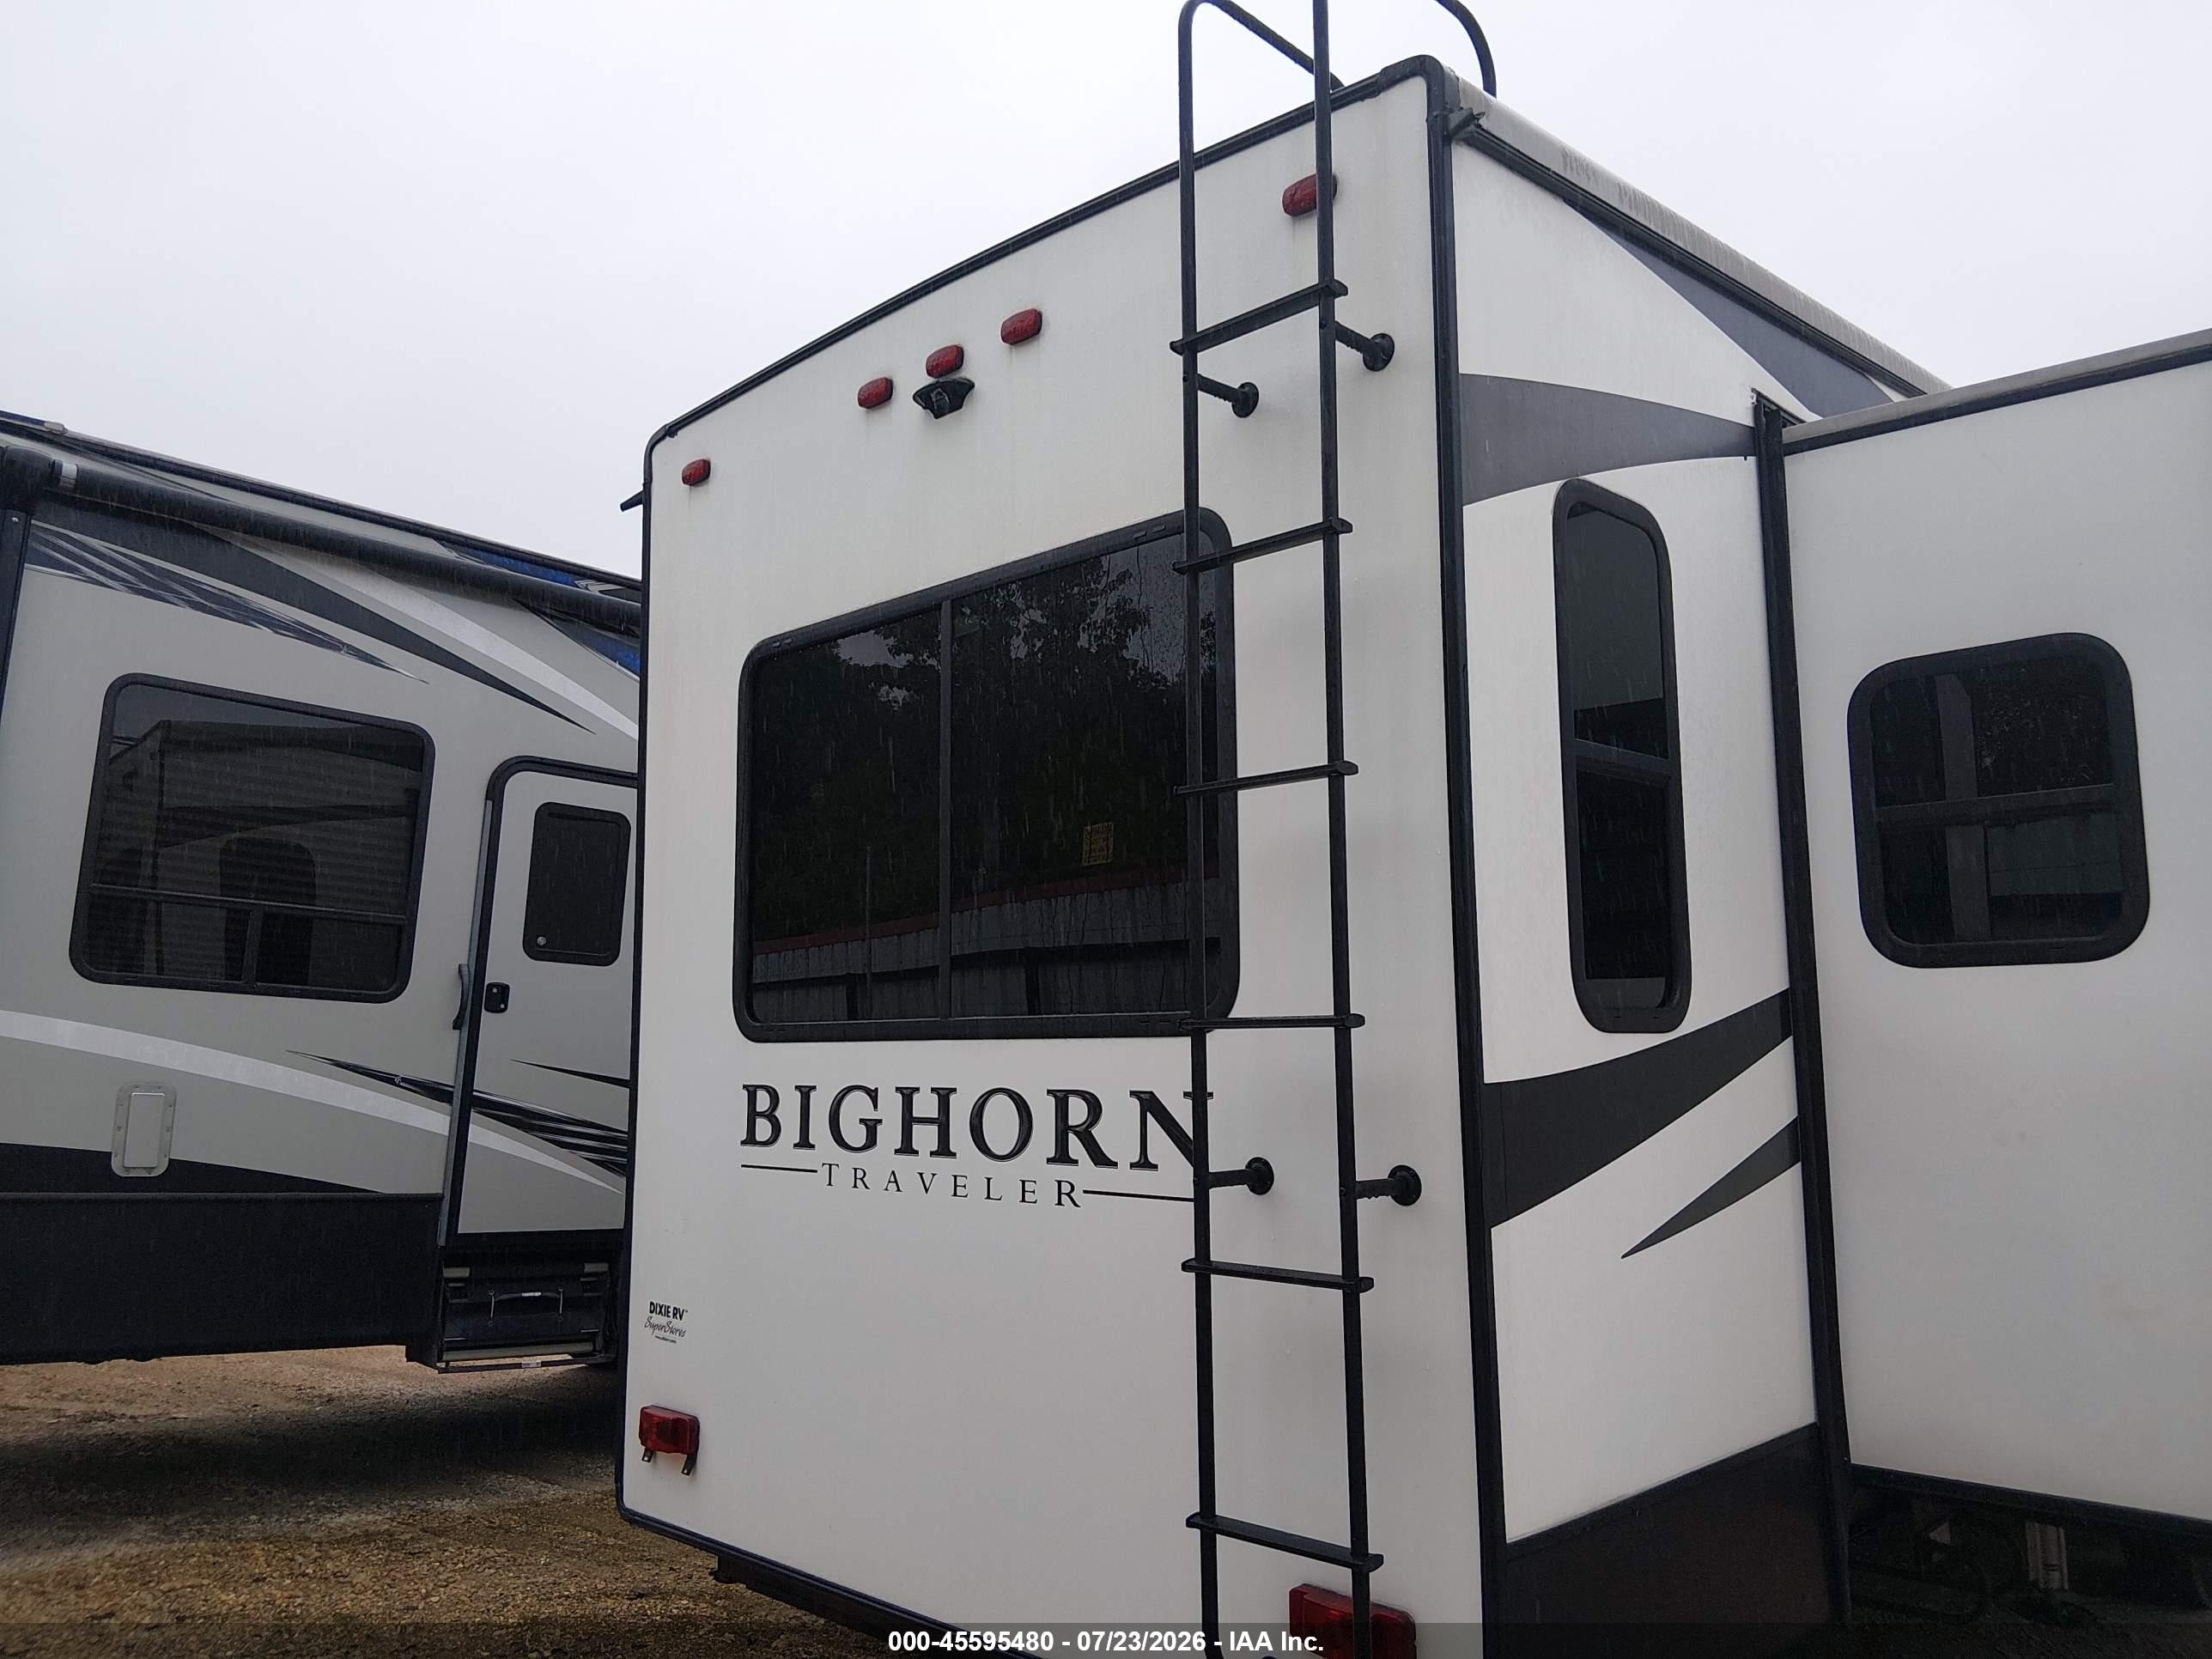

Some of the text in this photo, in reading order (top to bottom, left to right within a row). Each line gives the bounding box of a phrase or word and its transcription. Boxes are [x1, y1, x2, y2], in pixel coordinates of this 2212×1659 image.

[740, 1084, 1213, 1171] BIGHORN
[821, 1162, 1081, 1207] TRAVELER
[644, 1316, 686, 1337] SuperStores
[649, 1301, 685, 1321] DIXIE RV
